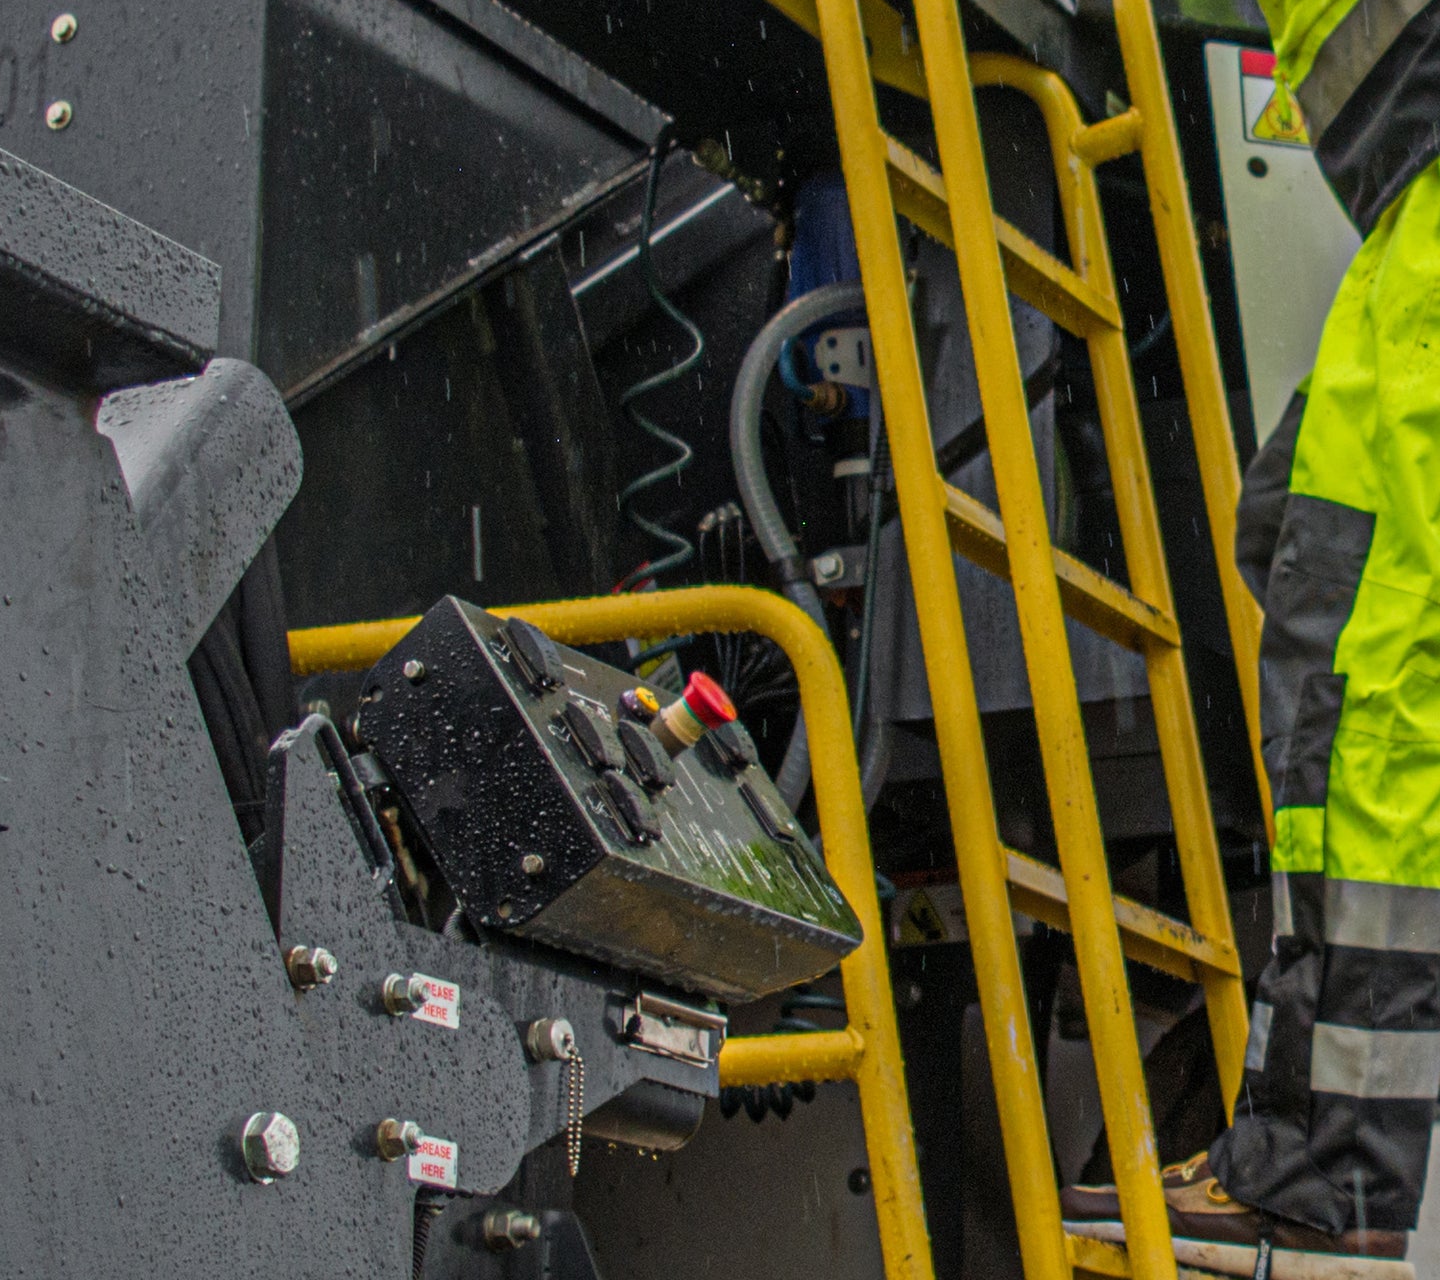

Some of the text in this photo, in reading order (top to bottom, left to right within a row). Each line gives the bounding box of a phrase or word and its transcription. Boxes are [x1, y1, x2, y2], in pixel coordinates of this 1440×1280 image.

[424, 982, 455, 1003] EASE
[423, 1004, 448, 1021] HERE
[421, 1163, 446, 1180] HERE
